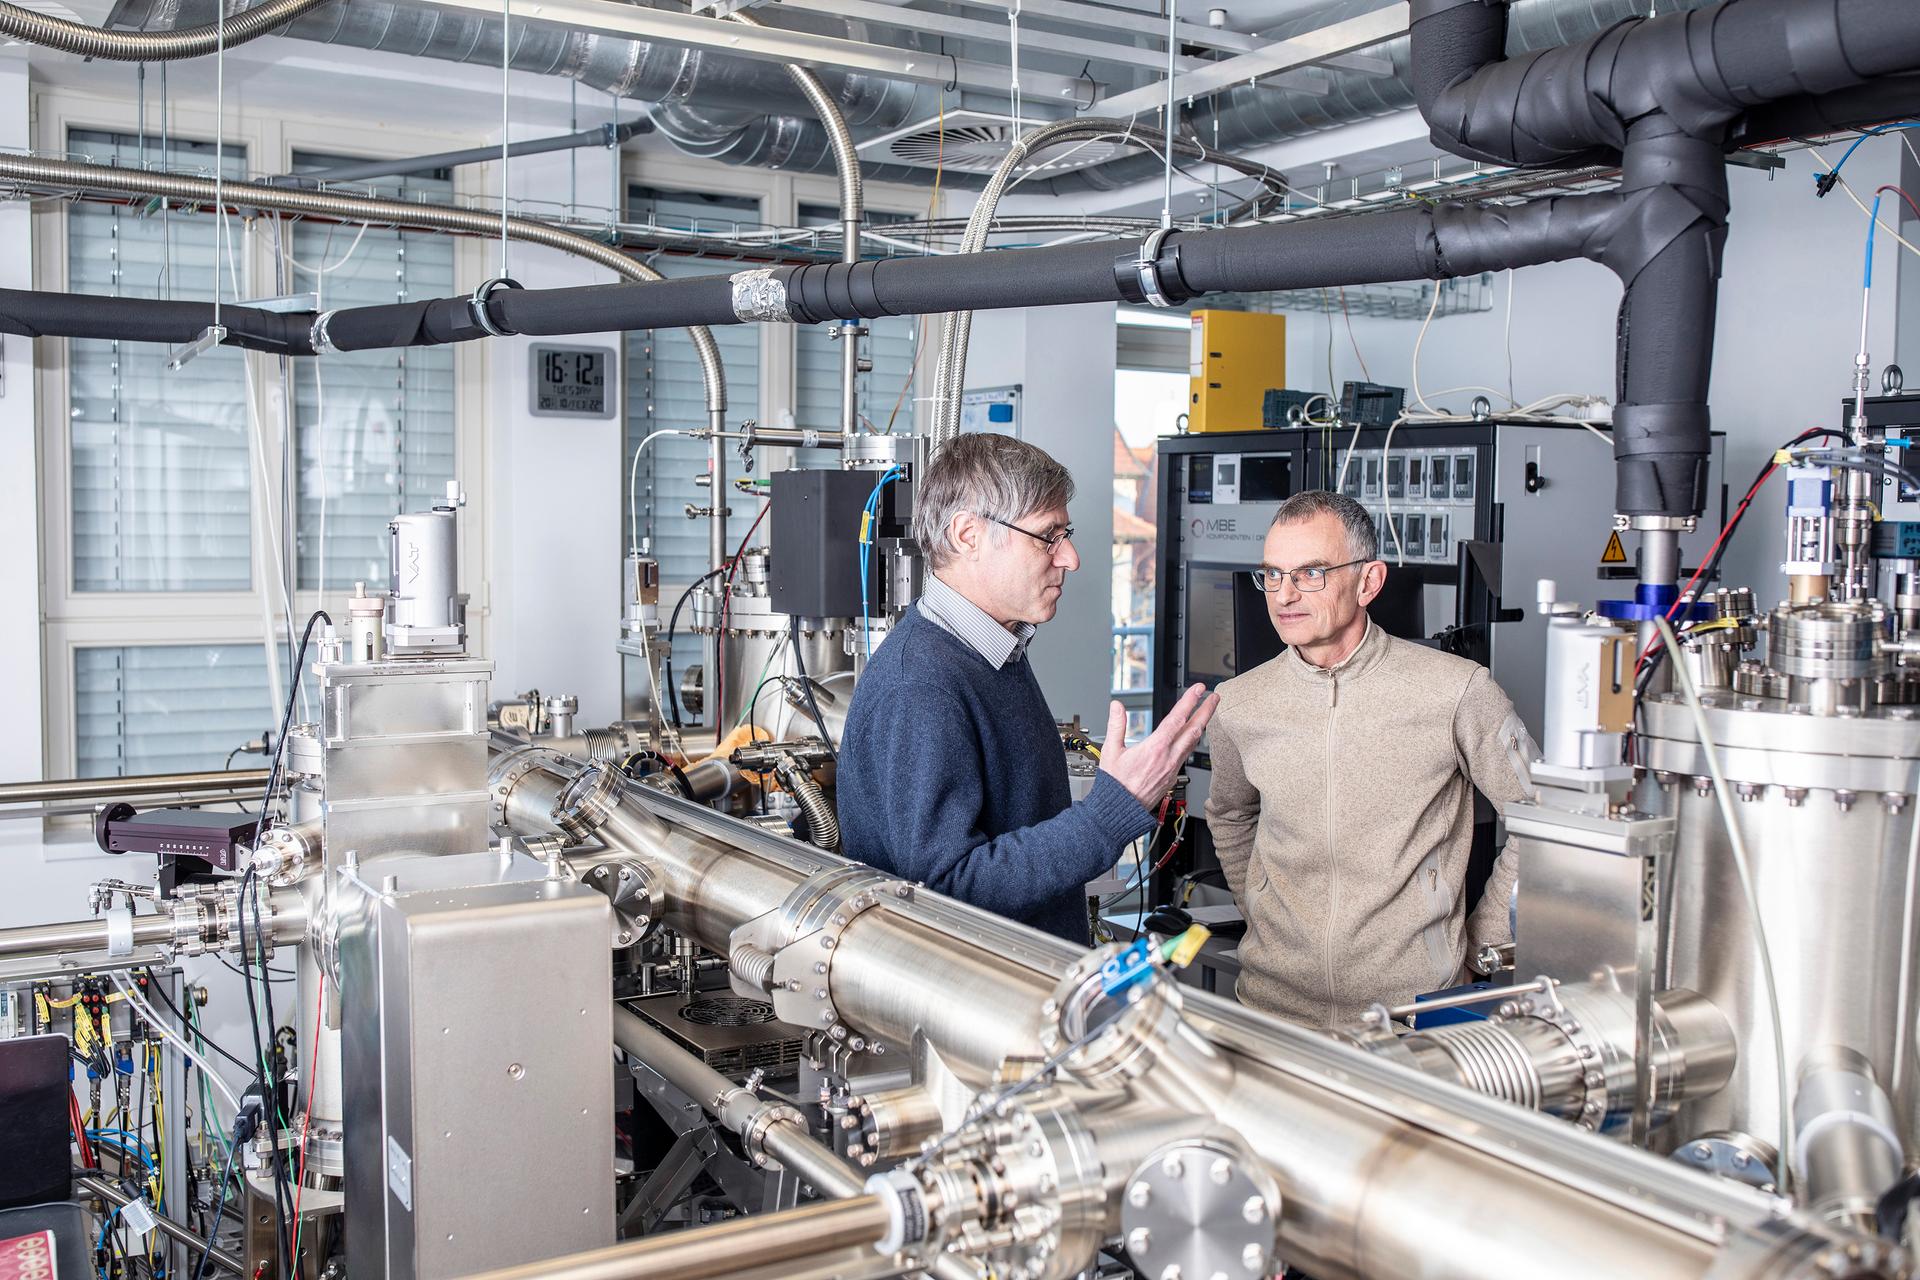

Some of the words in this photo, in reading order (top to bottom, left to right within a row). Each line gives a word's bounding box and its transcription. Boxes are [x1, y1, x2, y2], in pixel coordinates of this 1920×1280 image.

[546, 352, 594, 386] 16:12
[553, 385, 592, 395] TUESDAY
[1206, 533, 1251, 541] KOMPONENTEN
[1207, 519, 1236, 532] MBE
[407, 541, 420, 584] VAT
[1641, 856, 1655, 921] VAT
